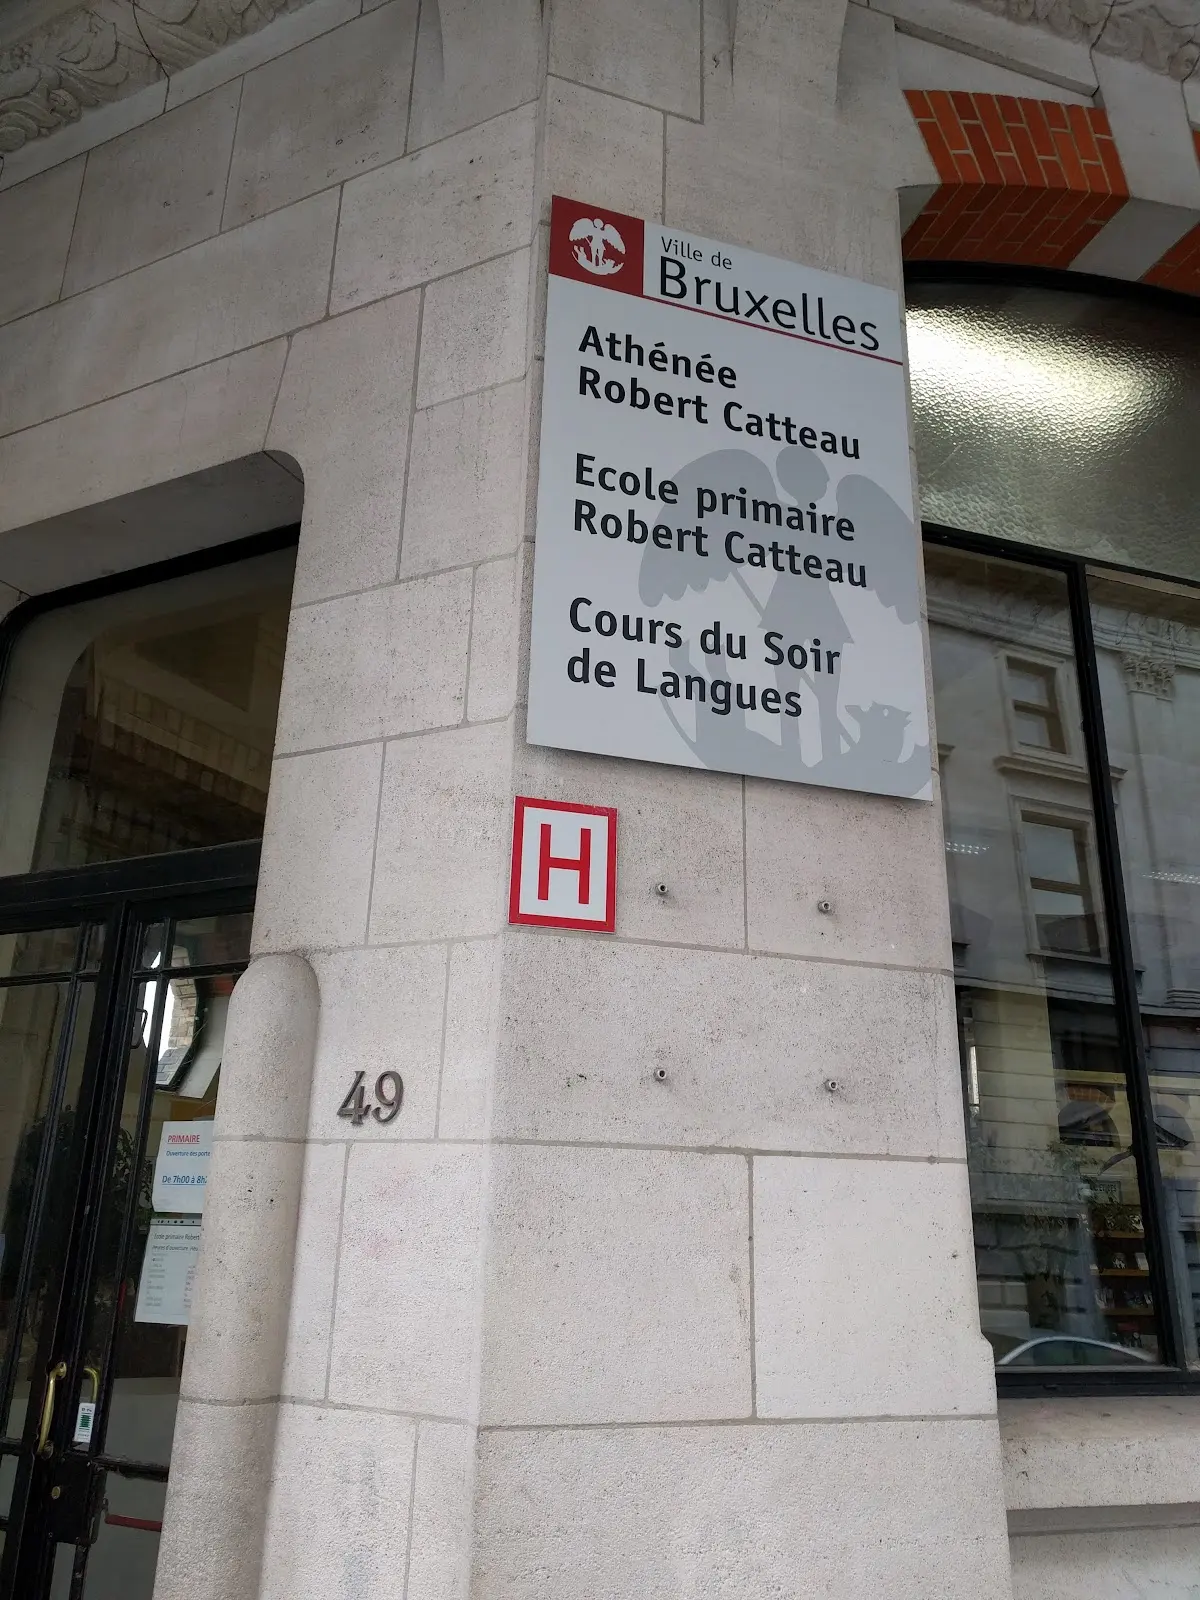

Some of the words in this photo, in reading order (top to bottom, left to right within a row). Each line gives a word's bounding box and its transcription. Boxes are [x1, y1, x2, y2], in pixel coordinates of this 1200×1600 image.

[660, 235, 703, 263] Ville
[710, 251, 733, 271] de
[660, 255, 880, 352] Bruxelles
[578, 324, 737, 389] Athénée
[578, 365, 709, 425] Robert
[723, 401, 861, 460] Catteau
[575, 452, 679, 505] Ecole
[696, 478, 856, 542] primaire
[574, 498, 709, 558] Robert
[724, 530, 868, 589] Catteau
[569, 597, 683, 649] Cours
[699, 620, 747, 660] du
[763, 631, 841, 675] Soir
[567, 647, 617, 688] de
[637, 657, 803, 718] Langues
[537, 823, 592, 905] H
[336, 1070, 404, 1125] 49
[167, 1134, 200, 1144] PRIMAIRE
[162, 1175, 171, 1184] De
[173, 1175, 190, 1184] 7h00
